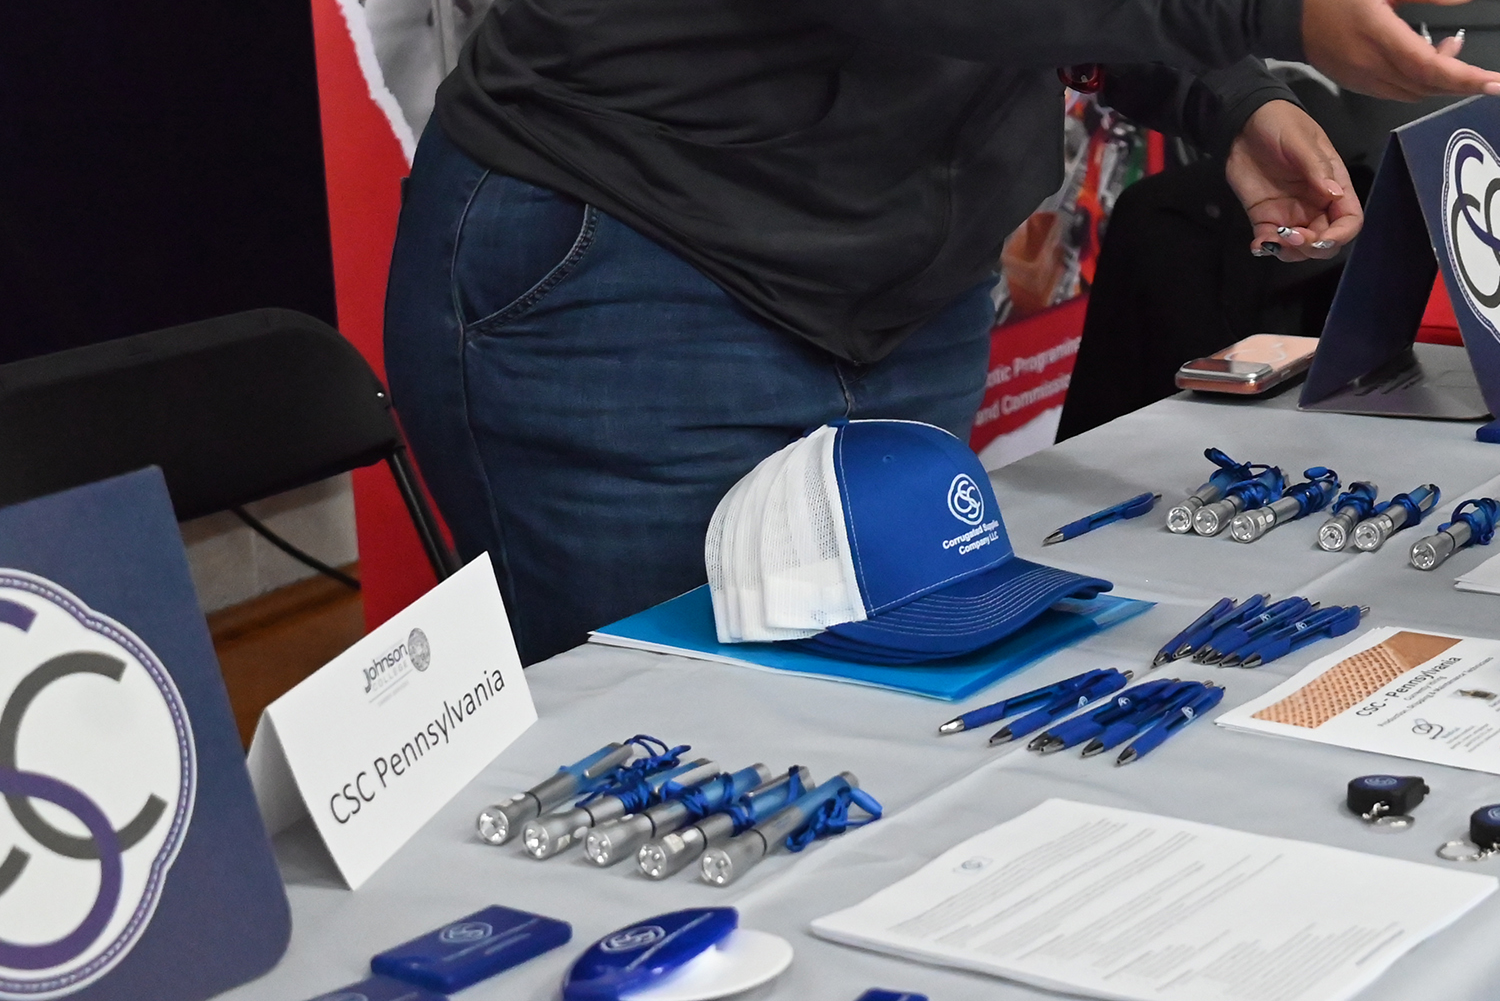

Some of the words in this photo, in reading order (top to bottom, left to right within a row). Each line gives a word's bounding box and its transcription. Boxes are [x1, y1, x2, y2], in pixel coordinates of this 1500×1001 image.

[942, 524, 984, 550] Corrugated
[958, 536, 991, 555] Company
[363, 643, 409, 694] Johnson
[372, 659, 410, 692] COLLEGE
[1355, 701, 1387, 717] CSC
[1389, 656, 1463, 699] Pennsylvania
[329, 770, 376, 825] CSC
[373, 668, 506, 789] Pennsylvania
